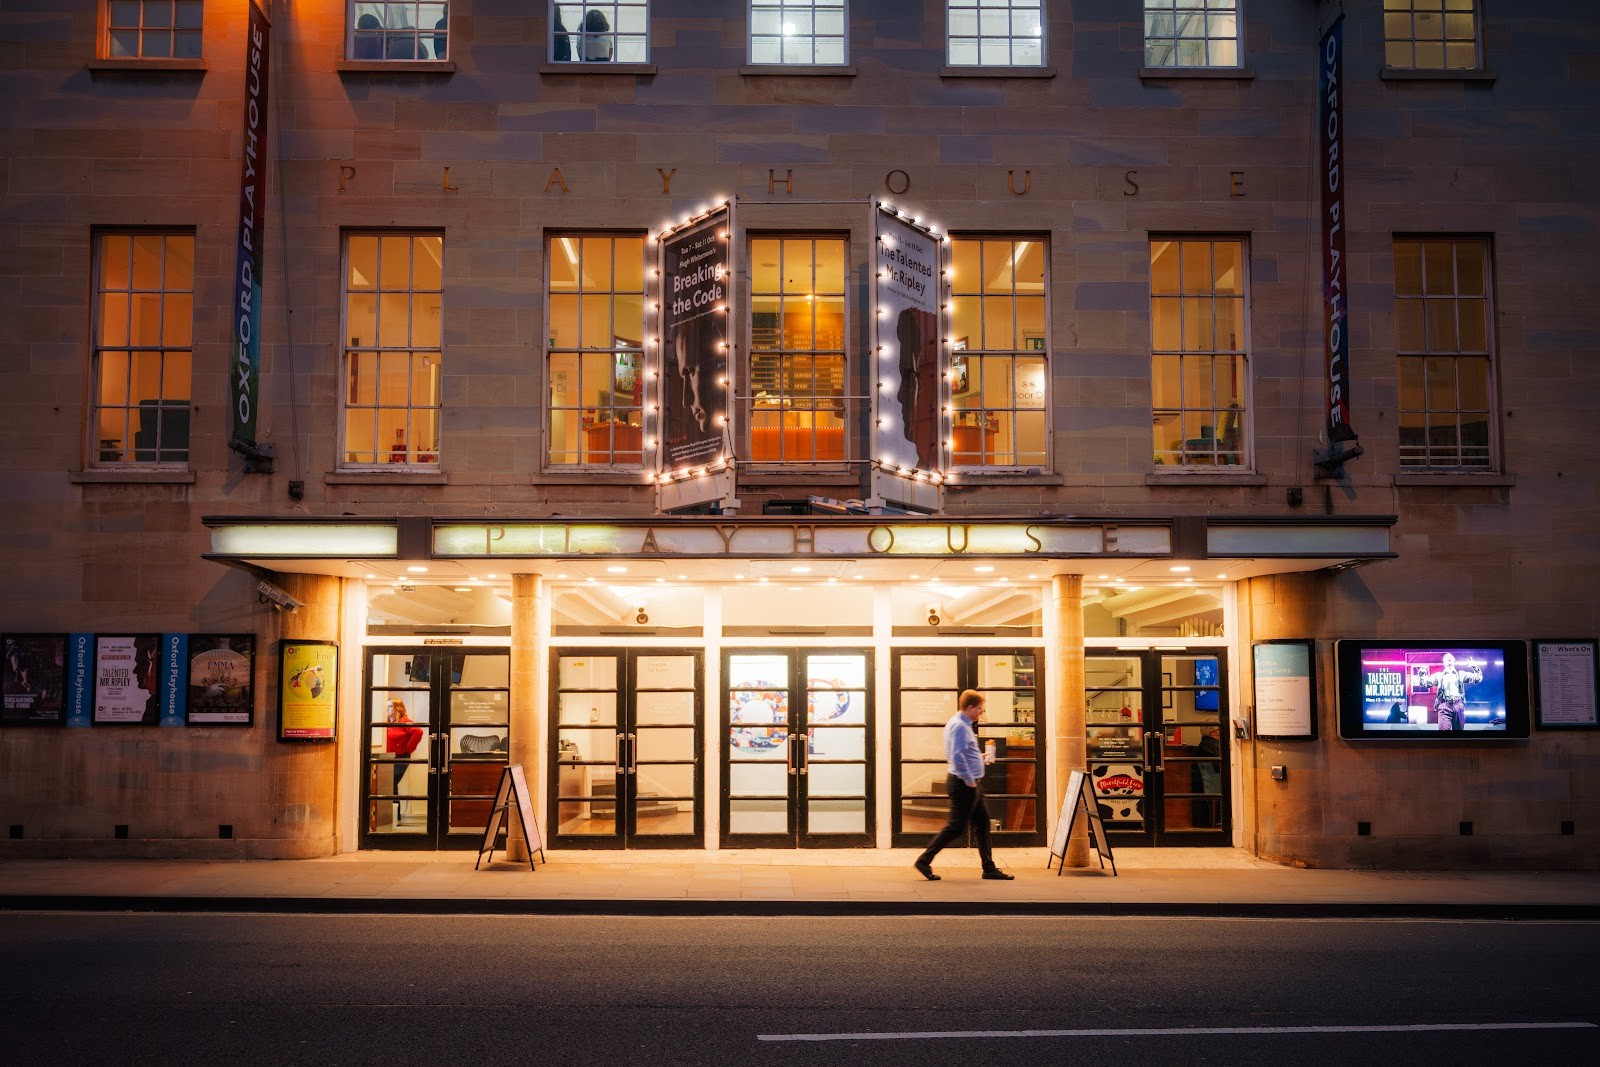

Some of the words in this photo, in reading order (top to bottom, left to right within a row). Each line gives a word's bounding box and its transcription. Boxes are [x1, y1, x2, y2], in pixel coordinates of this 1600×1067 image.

[1326, 35, 1339, 193] OXFORD
[243, 23, 262, 252] PLAYHOUSE
[338, 167, 1247, 198] PLAYHOUSE
[673, 262, 722, 293] Breaking
[896, 248, 932, 278] Talented
[672, 297, 691, 316] the
[693, 284, 722, 308] Code
[1329, 200, 1342, 428] PLAYHOUSE
[239, 260, 252, 424] OXFORD
[485, 524, 1120, 554] PLAYHOUSE
[78, 636, 86, 668] Oxford
[170, 636, 180, 668] Oxford
[102, 669, 129, 678] TALENTED
[1368, 672, 1402, 684] TALENTED
[74, 670, 84, 714] Playhouse
[168, 669, 178, 714] Playhouse
